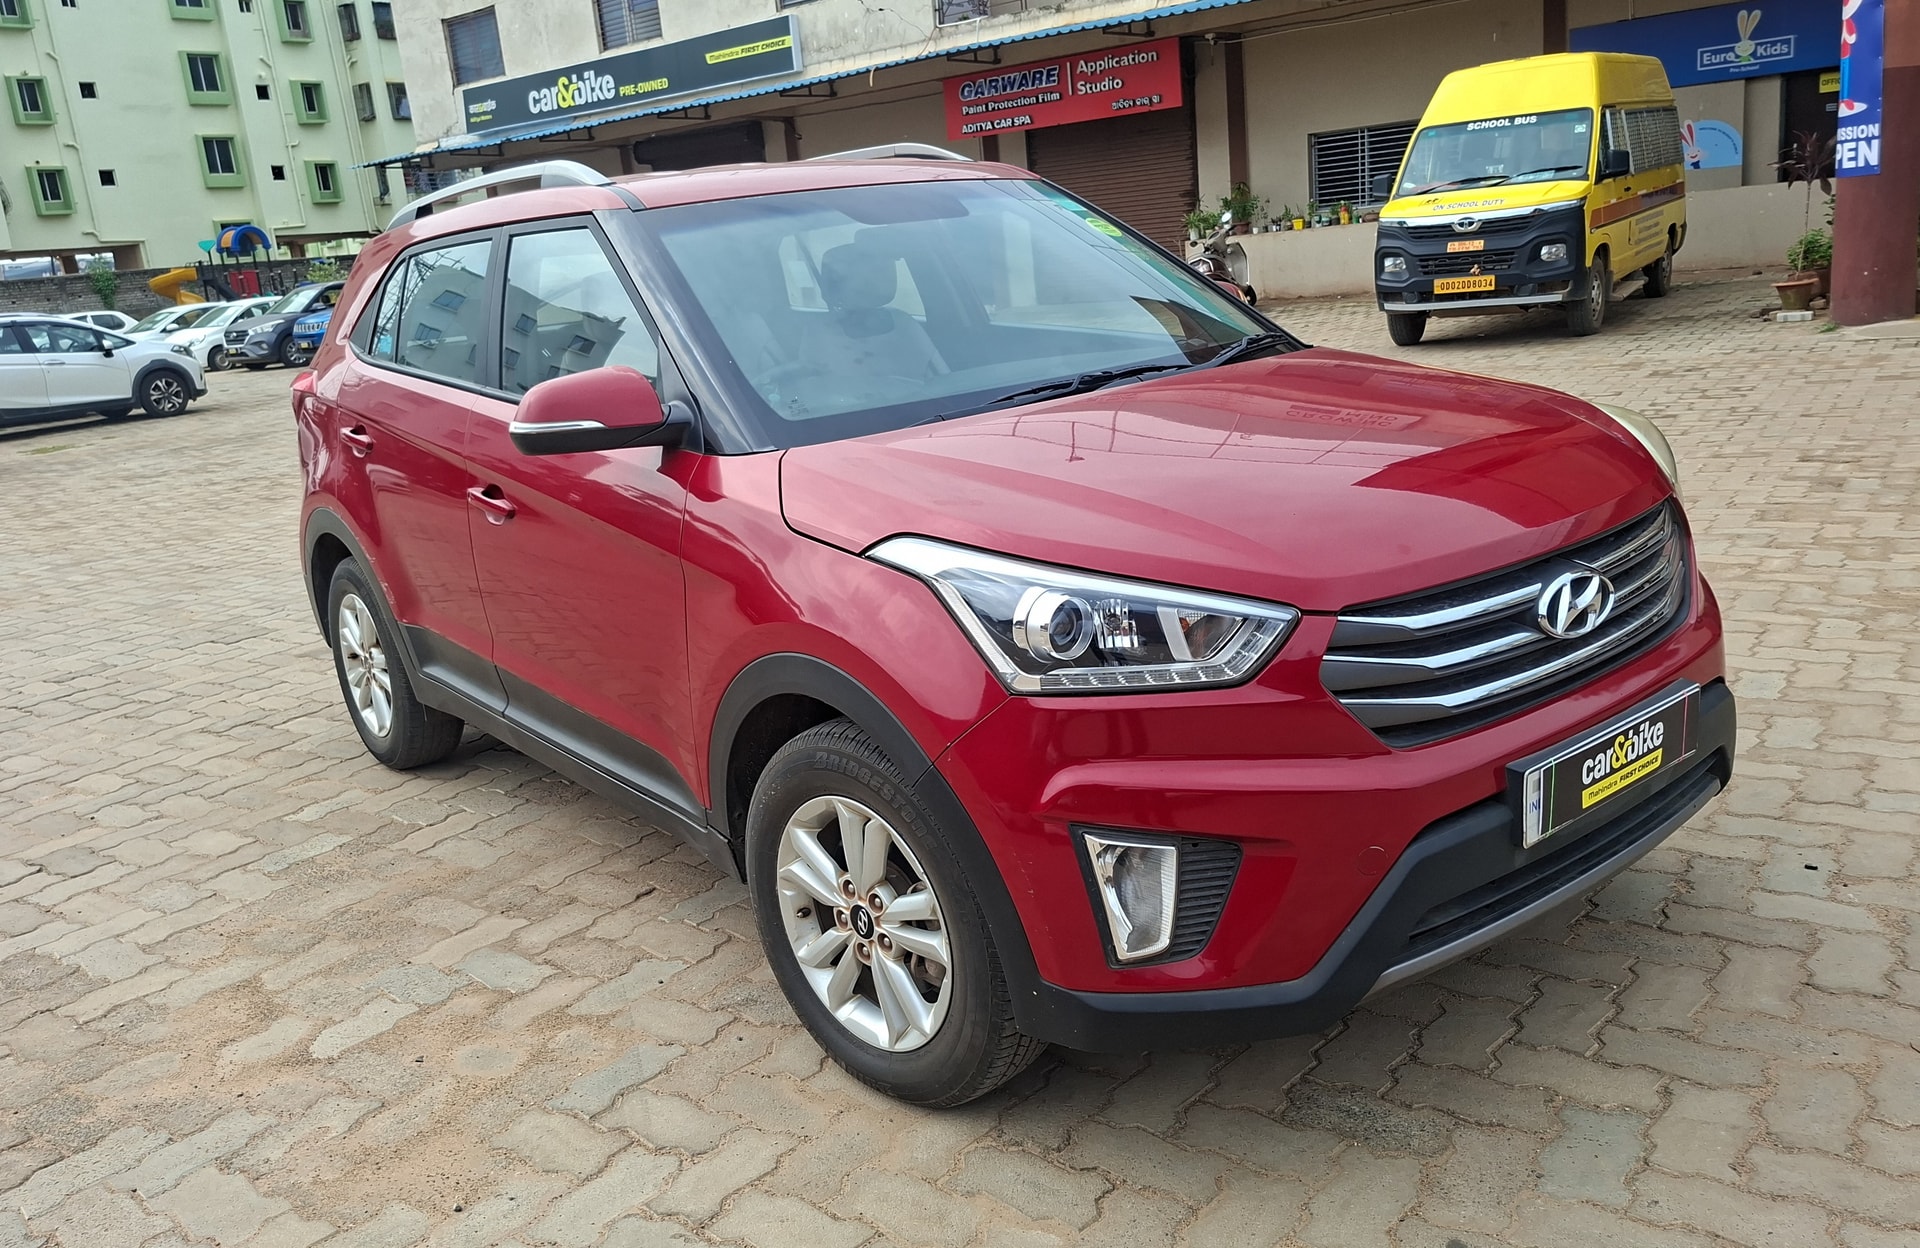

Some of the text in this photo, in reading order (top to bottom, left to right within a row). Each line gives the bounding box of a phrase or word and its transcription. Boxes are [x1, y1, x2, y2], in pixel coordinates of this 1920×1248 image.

[740, 44, 761, 55] FIRST
[761, 39, 787, 50] CHOICE
[1756, 42, 1789, 57] Kids
[1076, 50, 1158, 76] Application
[528, 70, 616, 114] car&bike
[619, 78, 669, 97] PRE-OWNED
[959, 65, 1060, 101] GARWARE
[1077, 76, 1123, 95] Studio
[962, 92, 1061, 115] Paint Protection Film
[962, 115, 1032, 133] ADITYA CAR SPA
[1466, 115, 1538, 131] SCHOOL BUS
[1432, 198, 1506, 211] ON SCHOOL DUTY
[1582, 720, 1665, 785] car&bike
[1588, 755, 1659, 801] Mahindra FIRST CHOICE
[813, 751, 938, 849] BRIDGESTONE
